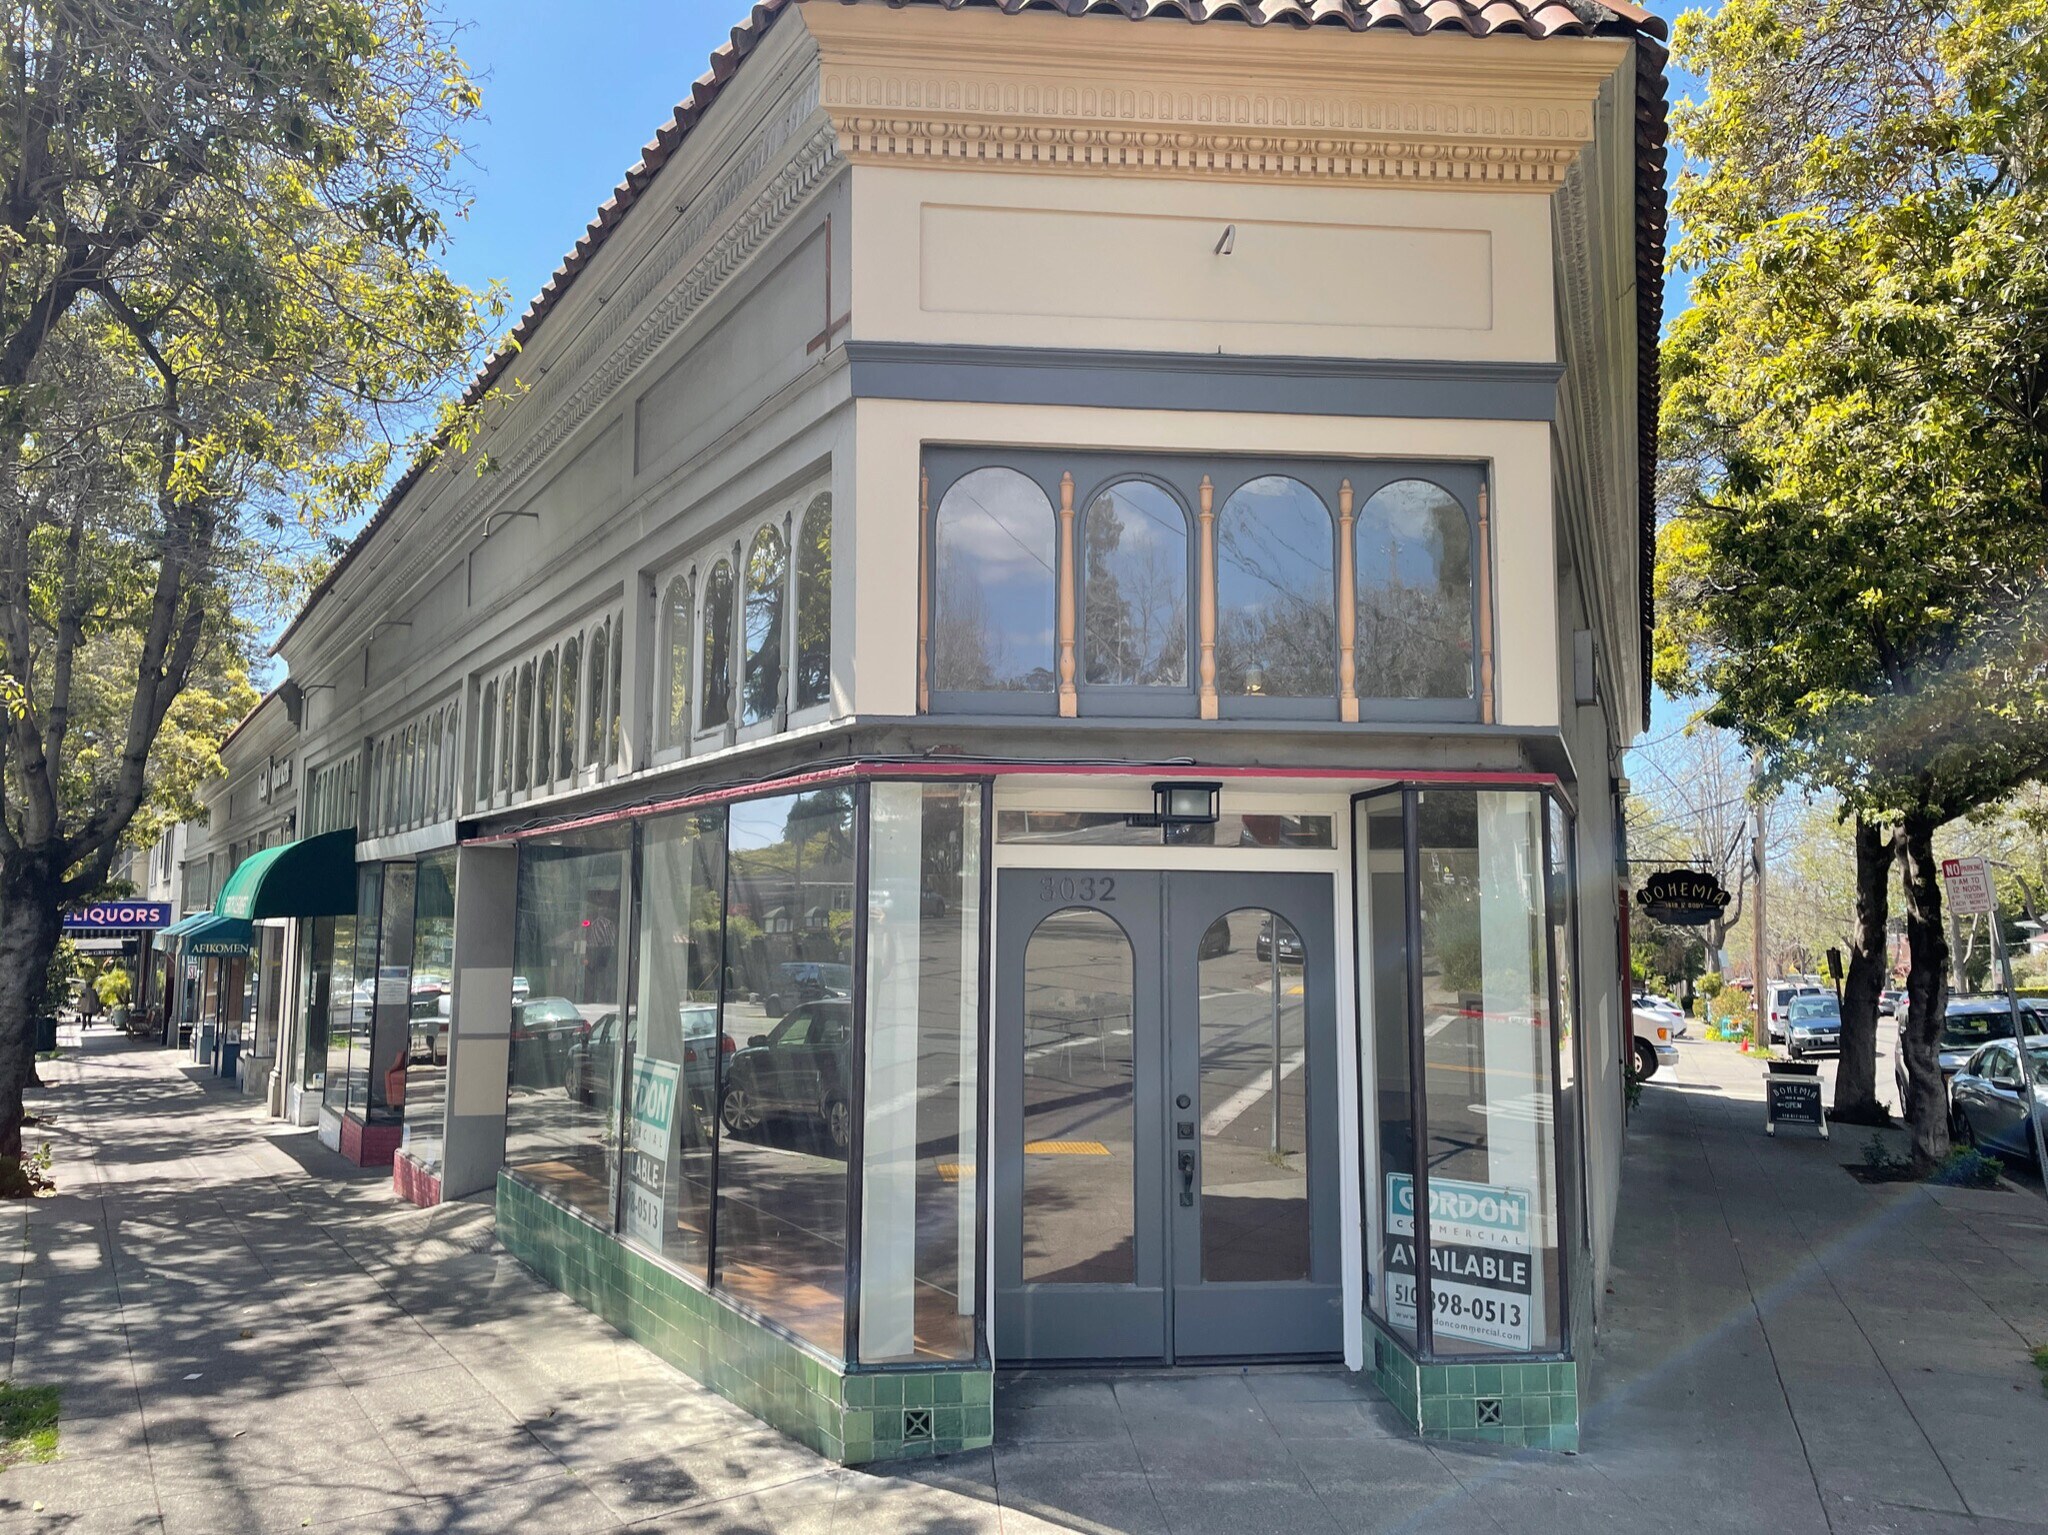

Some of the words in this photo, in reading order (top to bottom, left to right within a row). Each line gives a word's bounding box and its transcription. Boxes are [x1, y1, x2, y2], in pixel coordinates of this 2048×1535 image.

[1945, 864, 1960, 876] NO
[1960, 864, 1983, 872] PARKING
[1040, 877, 1116, 902] 3032
[1642, 882, 1725, 904] BOHEMIA
[73, 908, 160, 924] LIQUORS
[192, 944, 249, 953] AFIKOMEN
[1773, 1086, 1817, 1099] BOHEMIA
[1399, 1187, 1519, 1226] GORDON
[1397, 1220, 1521, 1244] COMERCIAL
